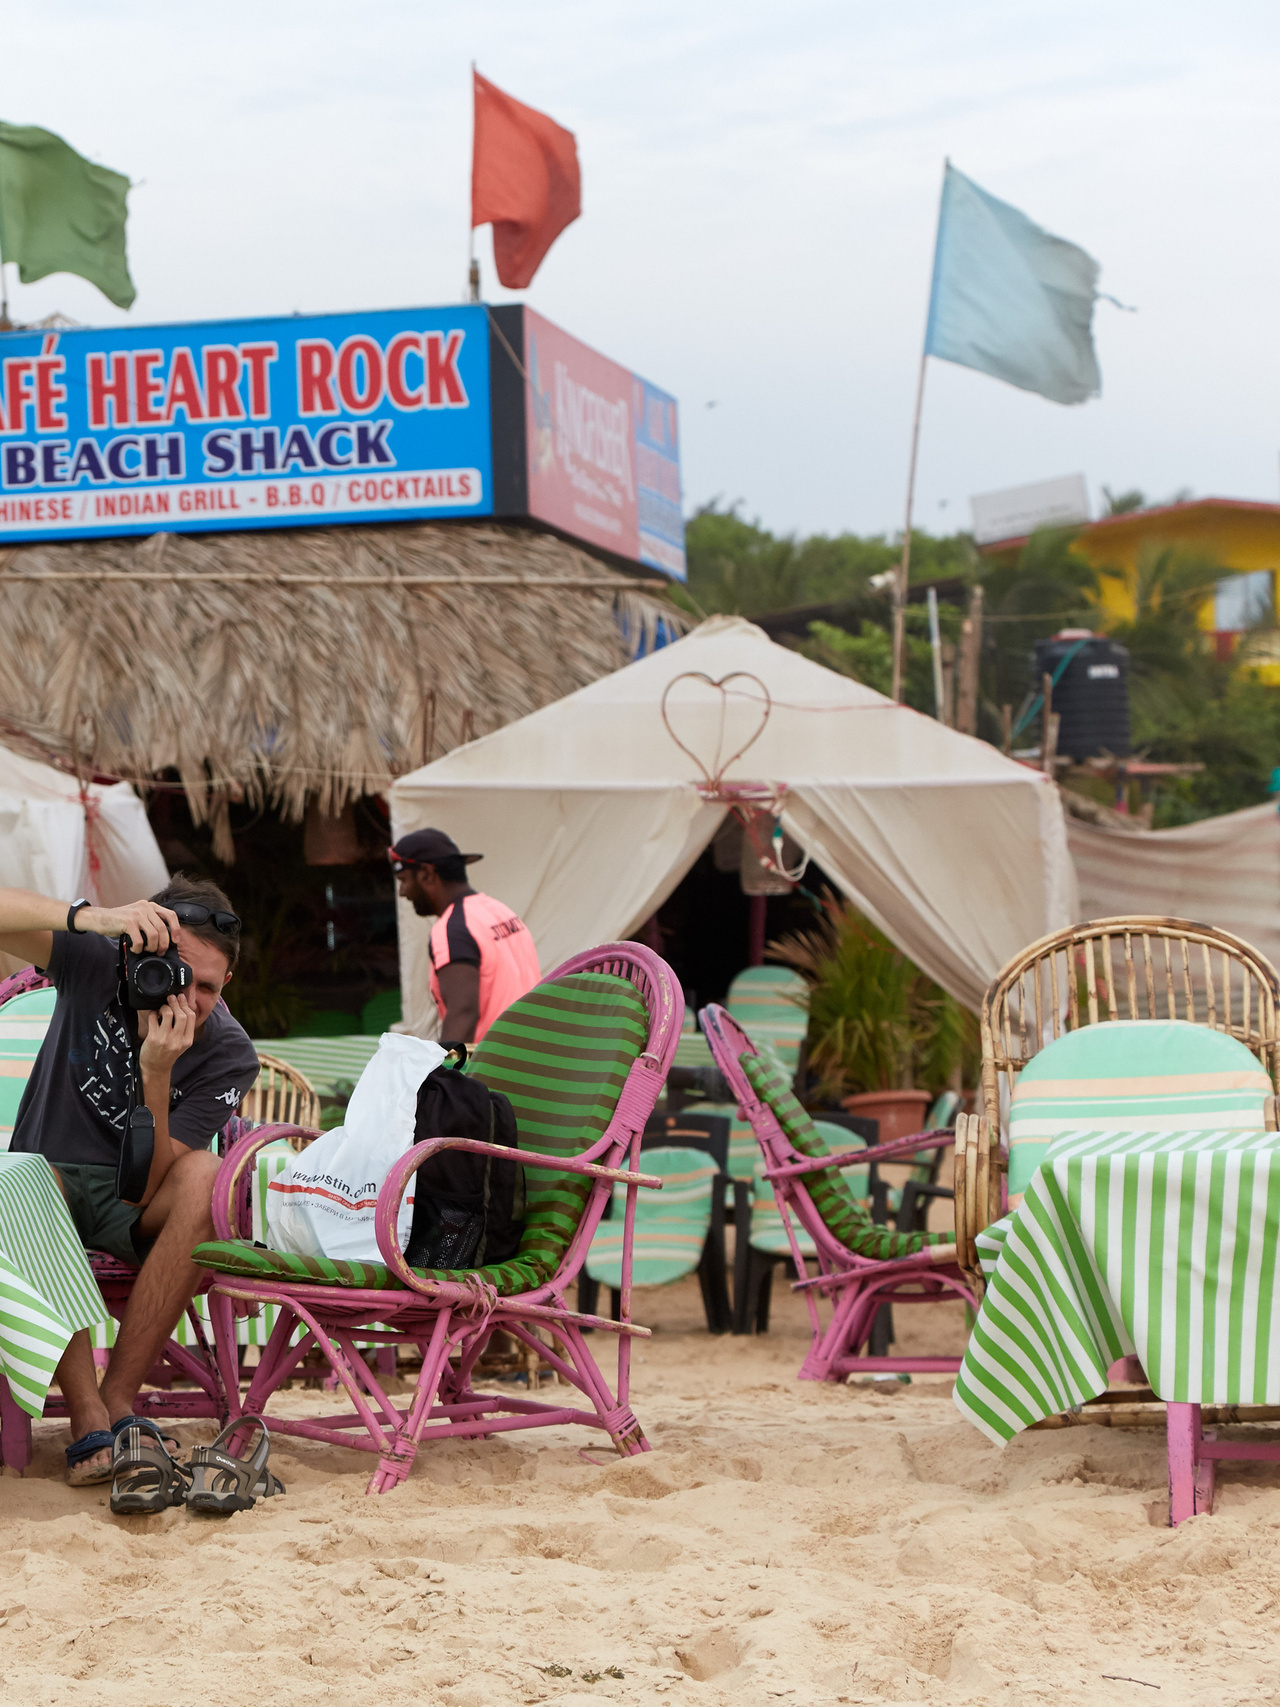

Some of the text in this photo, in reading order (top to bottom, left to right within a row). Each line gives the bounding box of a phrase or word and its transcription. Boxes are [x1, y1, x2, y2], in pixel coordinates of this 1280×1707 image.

[87, 342, 277, 425] HEART
[296, 330, 469, 416] ROCK
[3, 420, 396, 487] BEACH SHACK
[95, 491, 170, 517] INDIAN
[178, 487, 241, 514] GRILL
[266, 482, 326, 508] B.B.Q
[348, 474, 472, 503] COCKTAILS
